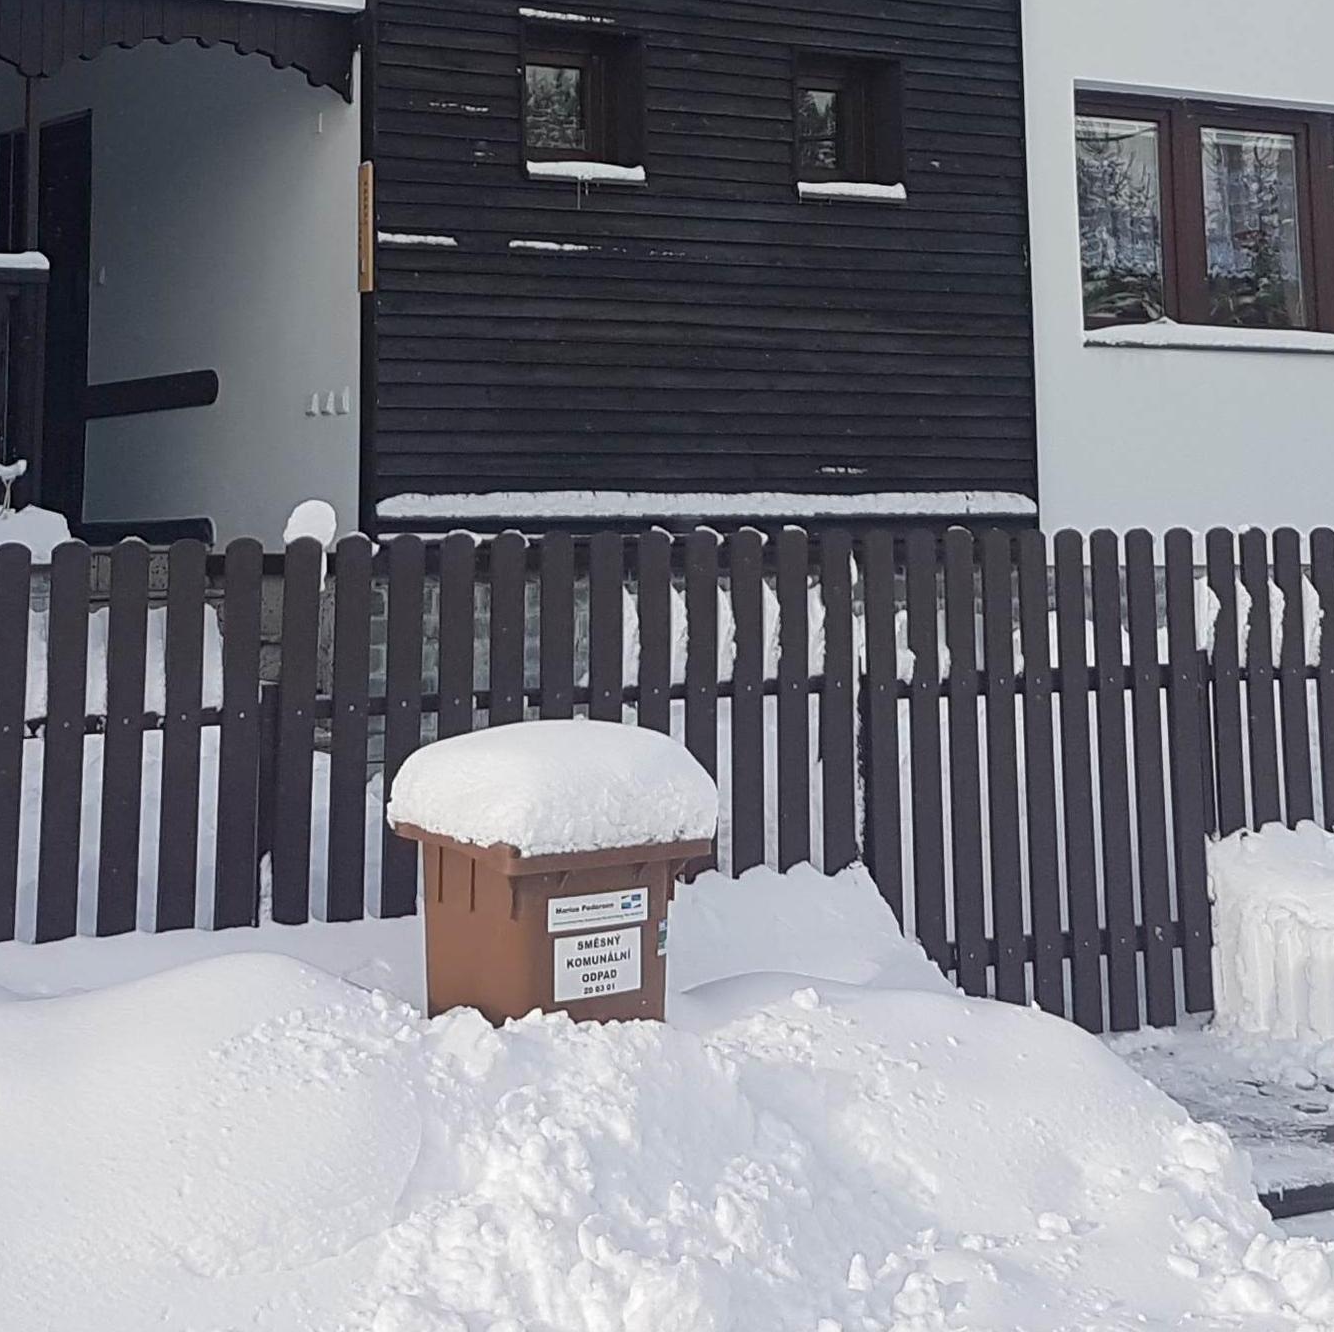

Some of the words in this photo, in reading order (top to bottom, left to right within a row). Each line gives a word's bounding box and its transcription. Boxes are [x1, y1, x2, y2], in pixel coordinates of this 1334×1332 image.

[566, 948, 631, 969] KOMUNÁLNÍ
[582, 969, 617, 983] ODPAD
[606, 983, 615, 991] 01
